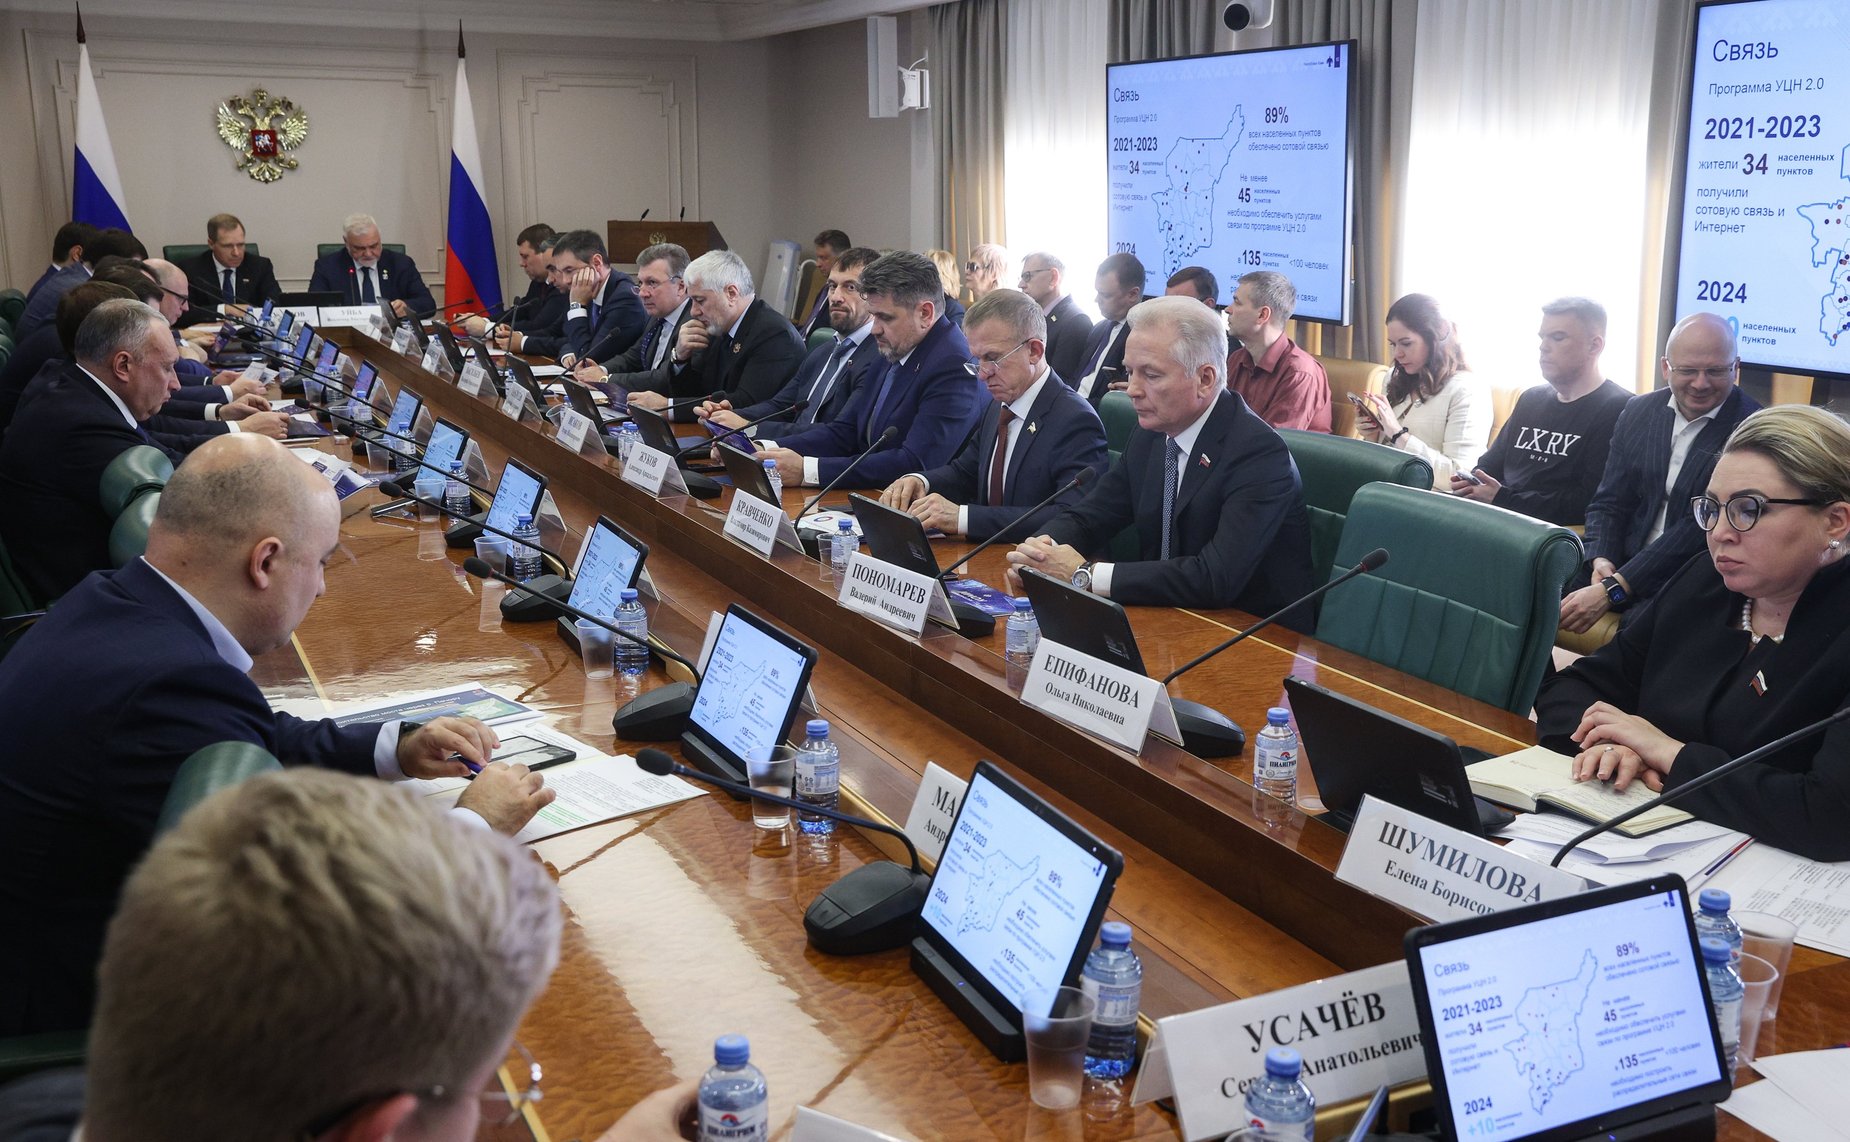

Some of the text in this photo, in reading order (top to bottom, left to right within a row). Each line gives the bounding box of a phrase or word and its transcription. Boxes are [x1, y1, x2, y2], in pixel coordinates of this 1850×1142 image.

[1713, 39, 1779, 62] Связь
[1113, 87, 1140, 103] Связь
[1709, 77, 1825, 98] Программа УЦН 2.0
[1264, 106, 1289, 124] 89%
[1704, 114, 1821, 140] 2021-2023
[1113, 136, 1158, 152] 2021-2023
[1129, 160, 1140, 175] 34
[1698, 153, 1835, 175] жители 34 населенных
[1776, 168, 1814, 178] пунктов
[1238, 187, 1251, 204] 45
[1697, 188, 1749, 201] получили
[1695, 205, 1785, 219] сотовую связь и
[1694, 220, 1746, 235] Интернет
[1116, 242, 1136, 256] 2024
[1242, 249, 1261, 266] 135
[1696, 279, 1748, 304] 2024
[1742, 323, 1797, 334] населенных
[1741, 335, 1777, 346] пунктов
[1514, 426, 1581, 457] LXRY
[736, 499, 774, 528] КРАВЧЕНКО
[852, 563, 926, 604] ПОНОМАРЕВ
[849, 586, 916, 622] Валерий Андреевич
[1044, 653, 1139, 709] ЕПИФАНОВА
[1045, 681, 1125, 726] Ольга Николаевна
[1377, 821, 1542, 903] ШУМИЛОВА
[1384, 860, 1429, 891] Елена
[1615, 941, 1640, 958] 89%
[1433, 961, 1471, 978] Связь
[1442, 994, 1503, 1022] 2021-2023
[1603, 1008, 1618, 1023] 45
[1243, 990, 1387, 1053] УСАЧЁВ
[1467, 1020, 1483, 1037] 34
[1618, 1053, 1639, 1071] 135
[1463, 1095, 1493, 1116] 2024
[1468, 1116, 1495, 1137] +10
